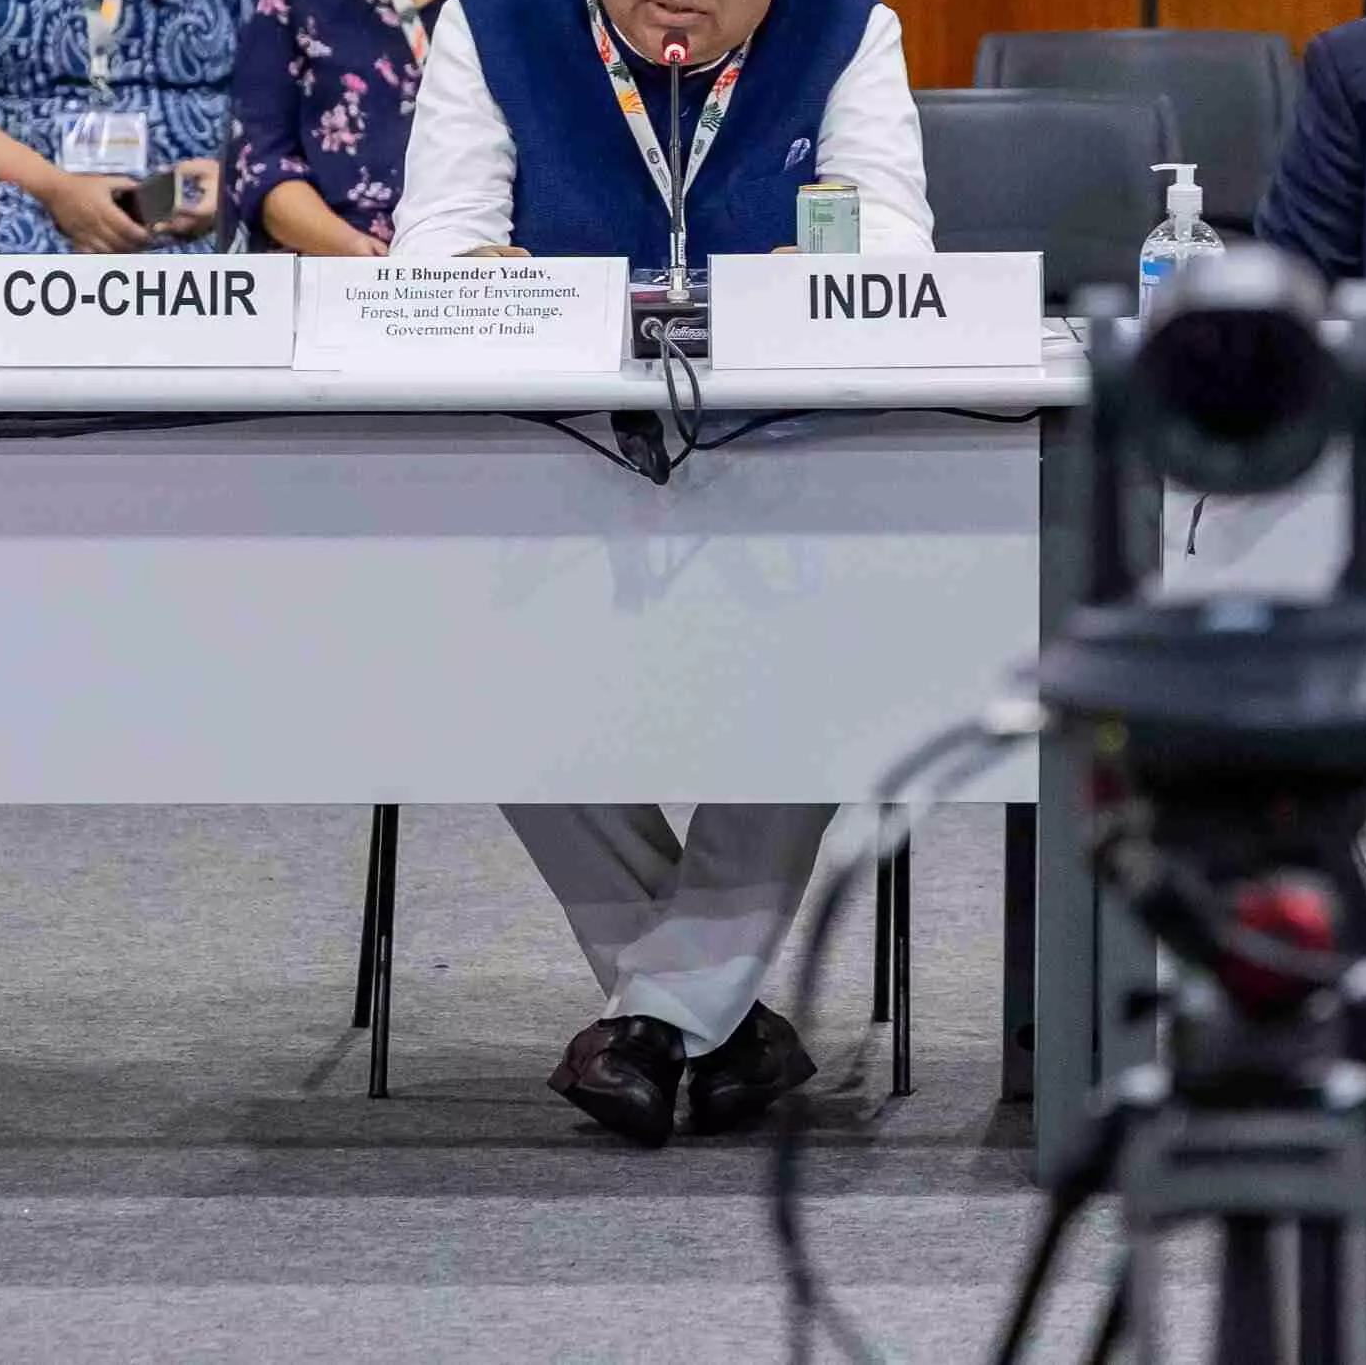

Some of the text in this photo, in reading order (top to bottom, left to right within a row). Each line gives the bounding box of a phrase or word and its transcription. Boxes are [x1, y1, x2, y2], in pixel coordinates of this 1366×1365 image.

[377, 266, 551, 283] H E Bhupender Yadav,
[3, 269, 258, 316] CO-CHAIR
[345, 285, 580, 301] Union Minister for Environment,
[809, 273, 948, 319] INDIA
[360, 303, 563, 320] Forest, and Climate Change,
[385, 321, 535, 337] Government of India
